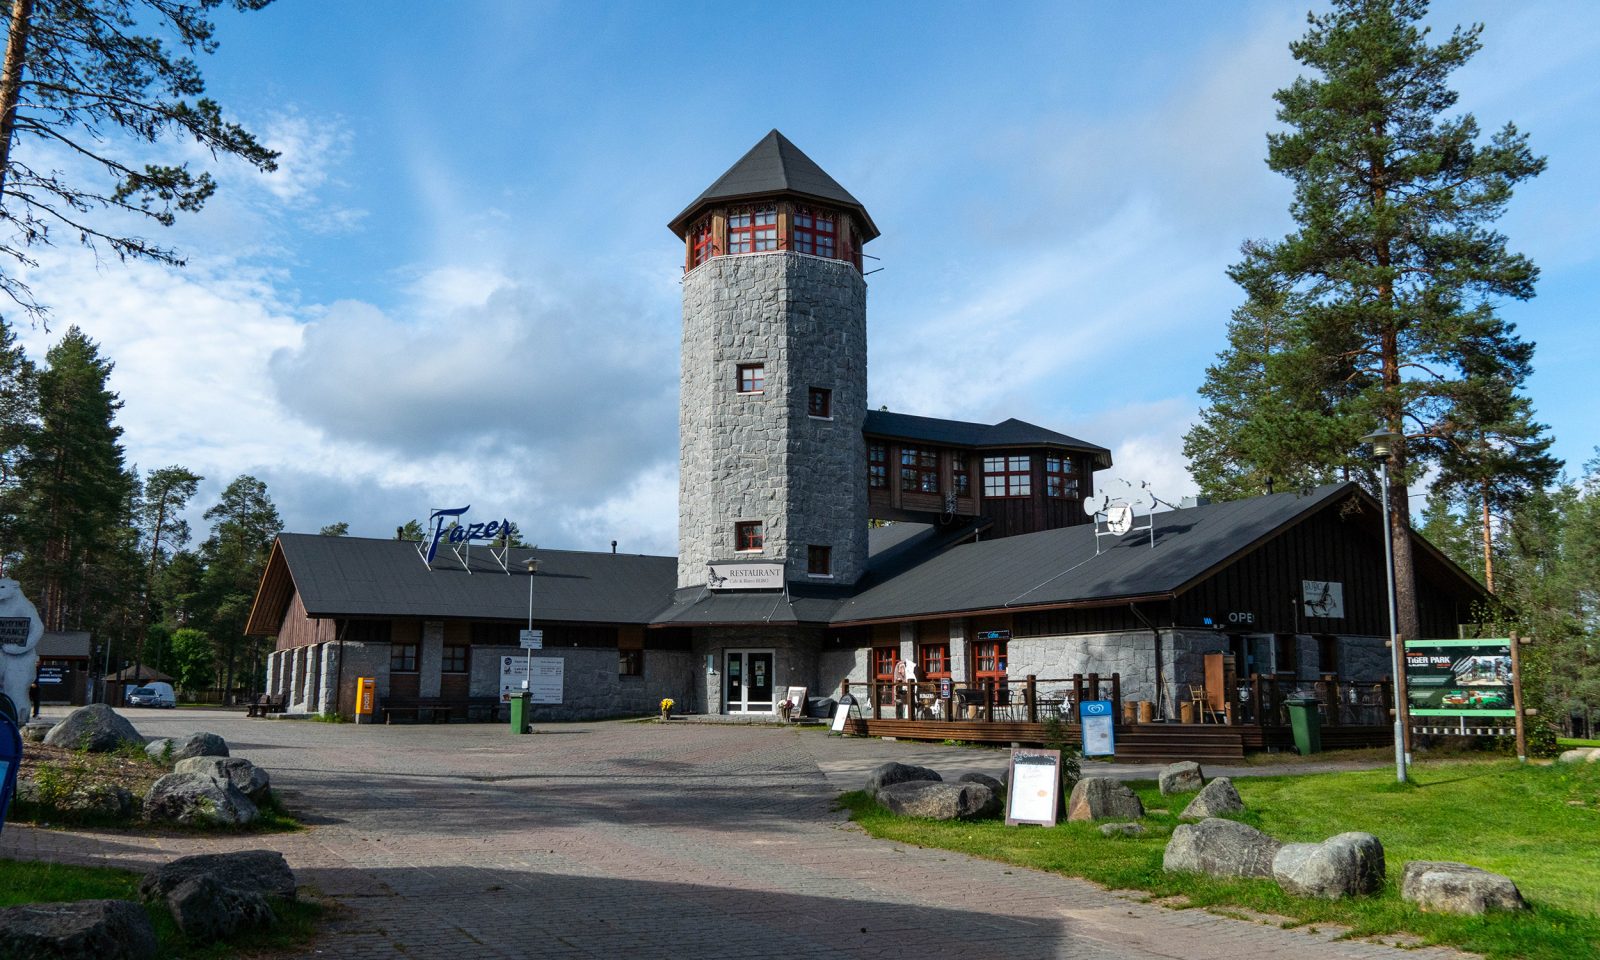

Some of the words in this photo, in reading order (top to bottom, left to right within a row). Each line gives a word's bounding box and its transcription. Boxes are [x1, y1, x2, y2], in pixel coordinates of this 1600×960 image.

[427, 505, 515, 563] Fazer
[729, 569, 780, 577] RESTAURANT
[1228, 612, 1254, 623] OPE
[1430, 656, 1451, 664] PARK
[363, 692, 371, 710] posti
